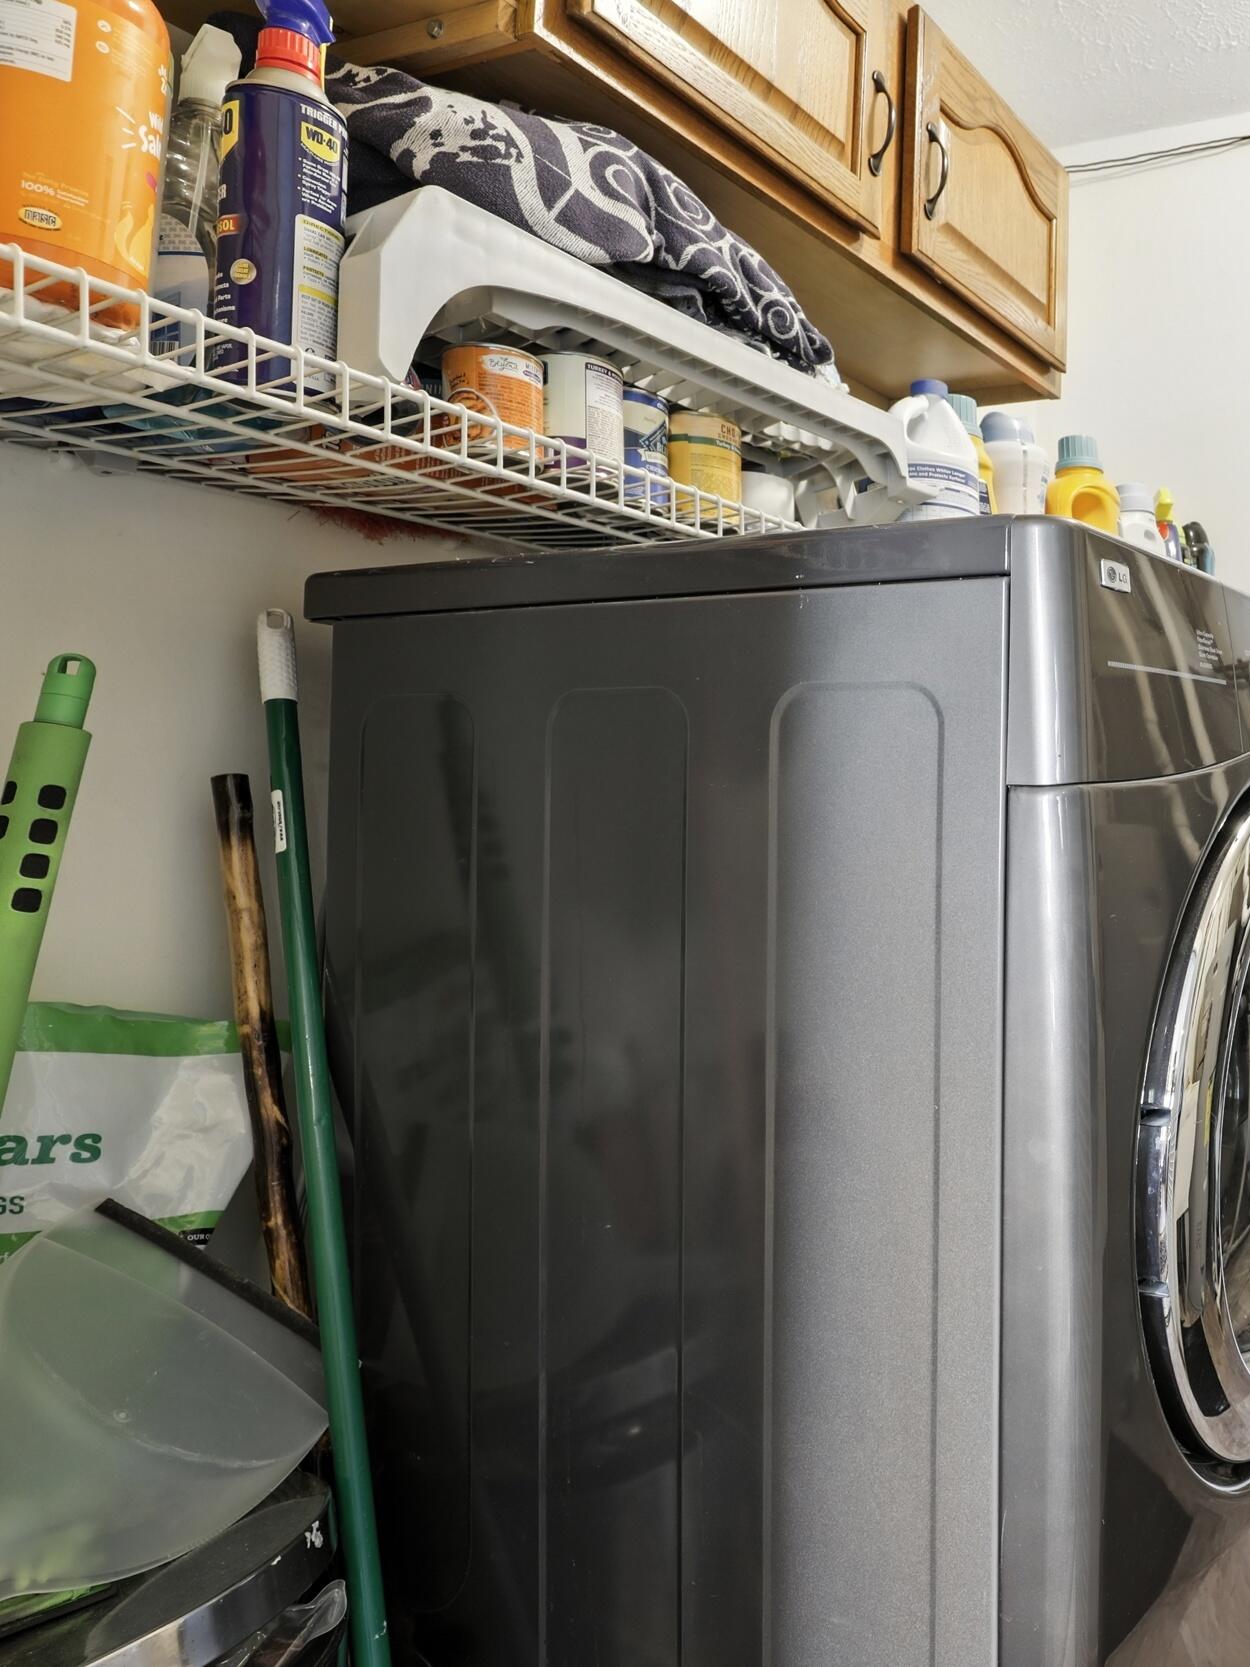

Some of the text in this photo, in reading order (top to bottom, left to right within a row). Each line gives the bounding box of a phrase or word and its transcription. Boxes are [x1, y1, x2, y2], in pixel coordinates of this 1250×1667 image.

[299, 103, 338, 132] TRIGGER
[304, 126, 338, 154] WD-40
[20, 179, 56, 197] 100%
[587, 363, 606, 375] TURKEY
[1118, 572, 1127, 584] LG
[0, 1133, 102, 1166] ars
[187, 1233, 205, 1241] OUR
